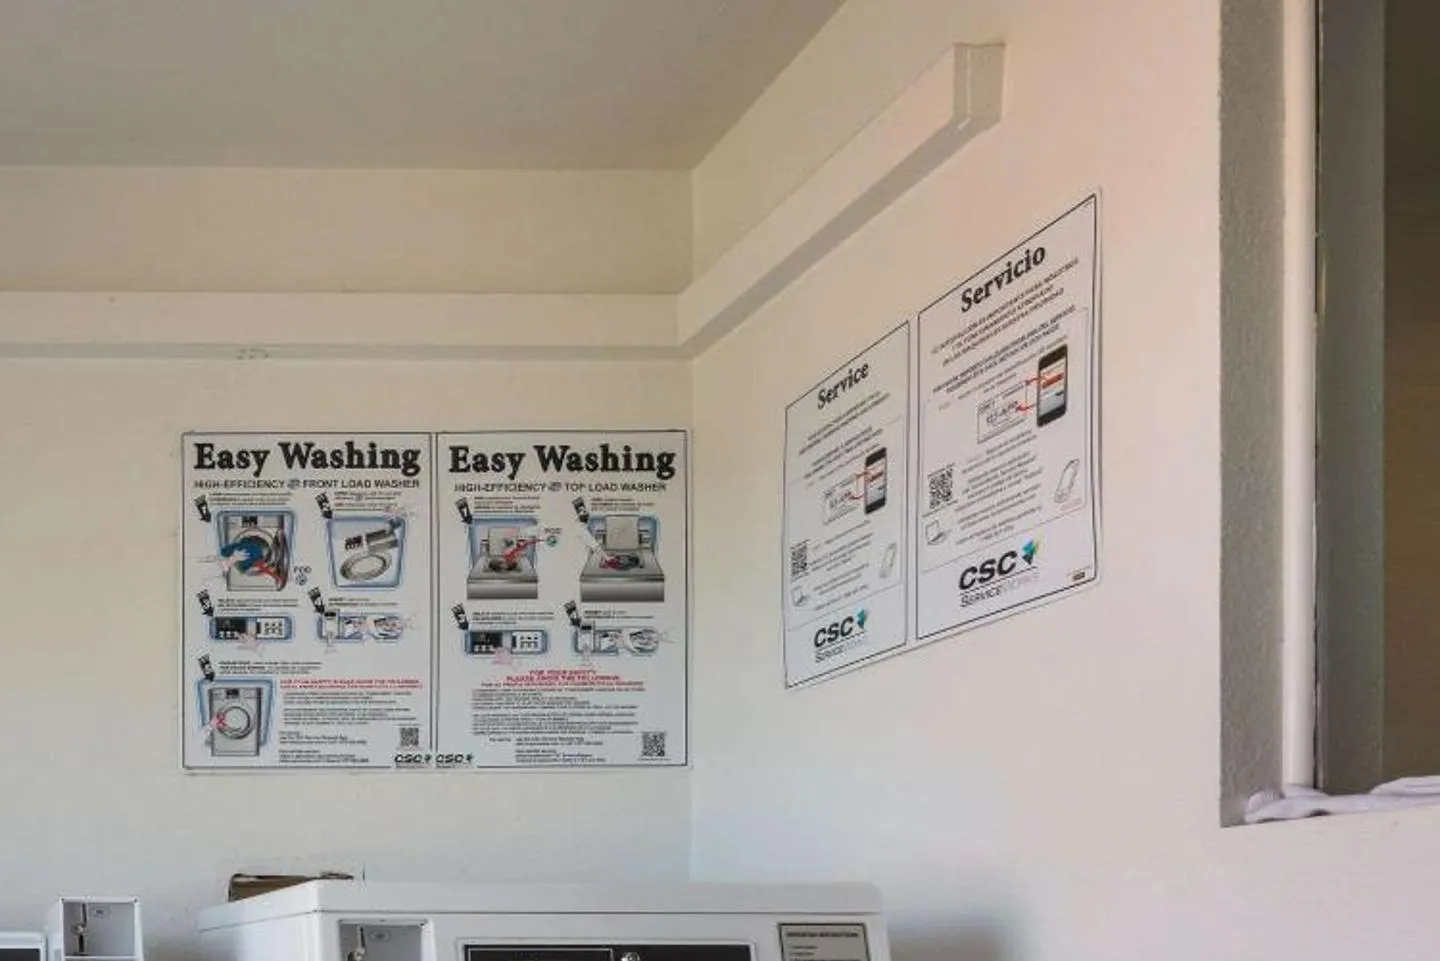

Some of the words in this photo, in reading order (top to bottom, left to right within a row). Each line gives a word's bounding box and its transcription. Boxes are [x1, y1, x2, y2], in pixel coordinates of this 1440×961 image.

[961, 246, 1046, 313] Servicio
[817, 362, 869, 410] Service
[193, 442, 271, 477] Easy
[278, 441, 421, 477] Washing
[448, 444, 526, 480] Easy
[532, 443, 677, 480] Washing
[193, 479, 285, 489] HIGH-EFFICIENCY
[303, 480, 338, 489] FRONT
[340, 480, 372, 489] LOAD
[374, 480, 420, 489] WASHER
[565, 483, 586, 492] TOP
[588, 483, 619, 492] LOAD
[621, 482, 667, 492] WASHER
[958, 550, 1018, 590] CSC
[813, 615, 854, 648] CSC
[394, 753, 422, 764] CSC
[435, 753, 464, 764] CSC
